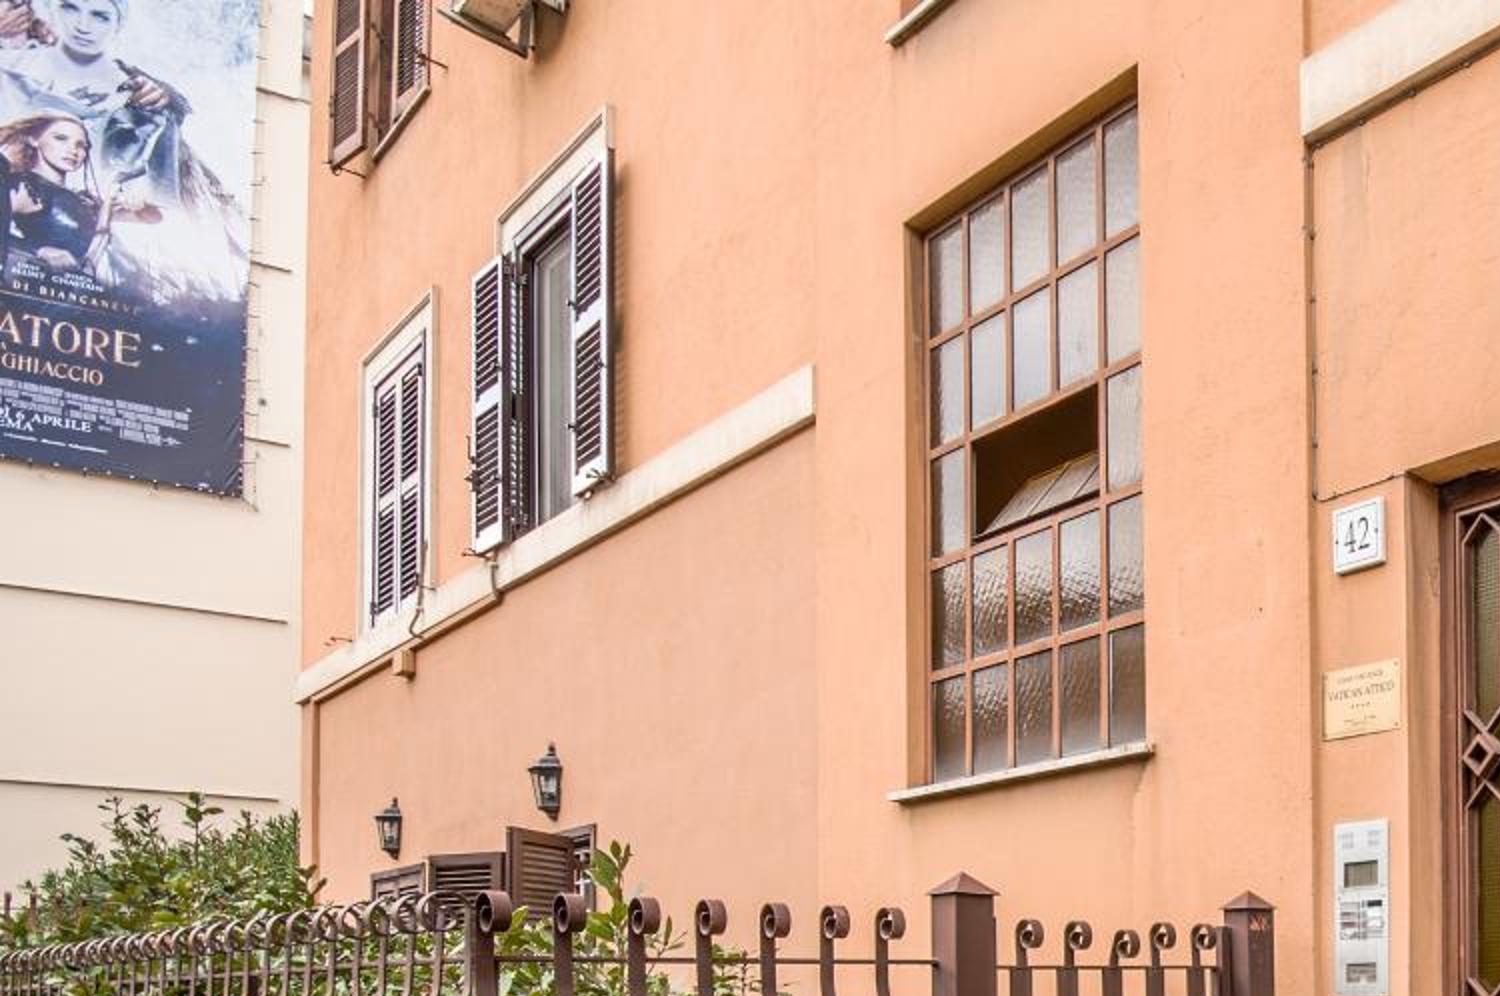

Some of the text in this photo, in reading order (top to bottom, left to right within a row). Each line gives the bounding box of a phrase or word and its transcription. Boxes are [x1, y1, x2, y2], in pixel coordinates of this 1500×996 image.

[1, 351, 104, 386] GHIACCIO
[32, 413, 92, 433] APRILE
[1344, 516, 1370, 554] 42
